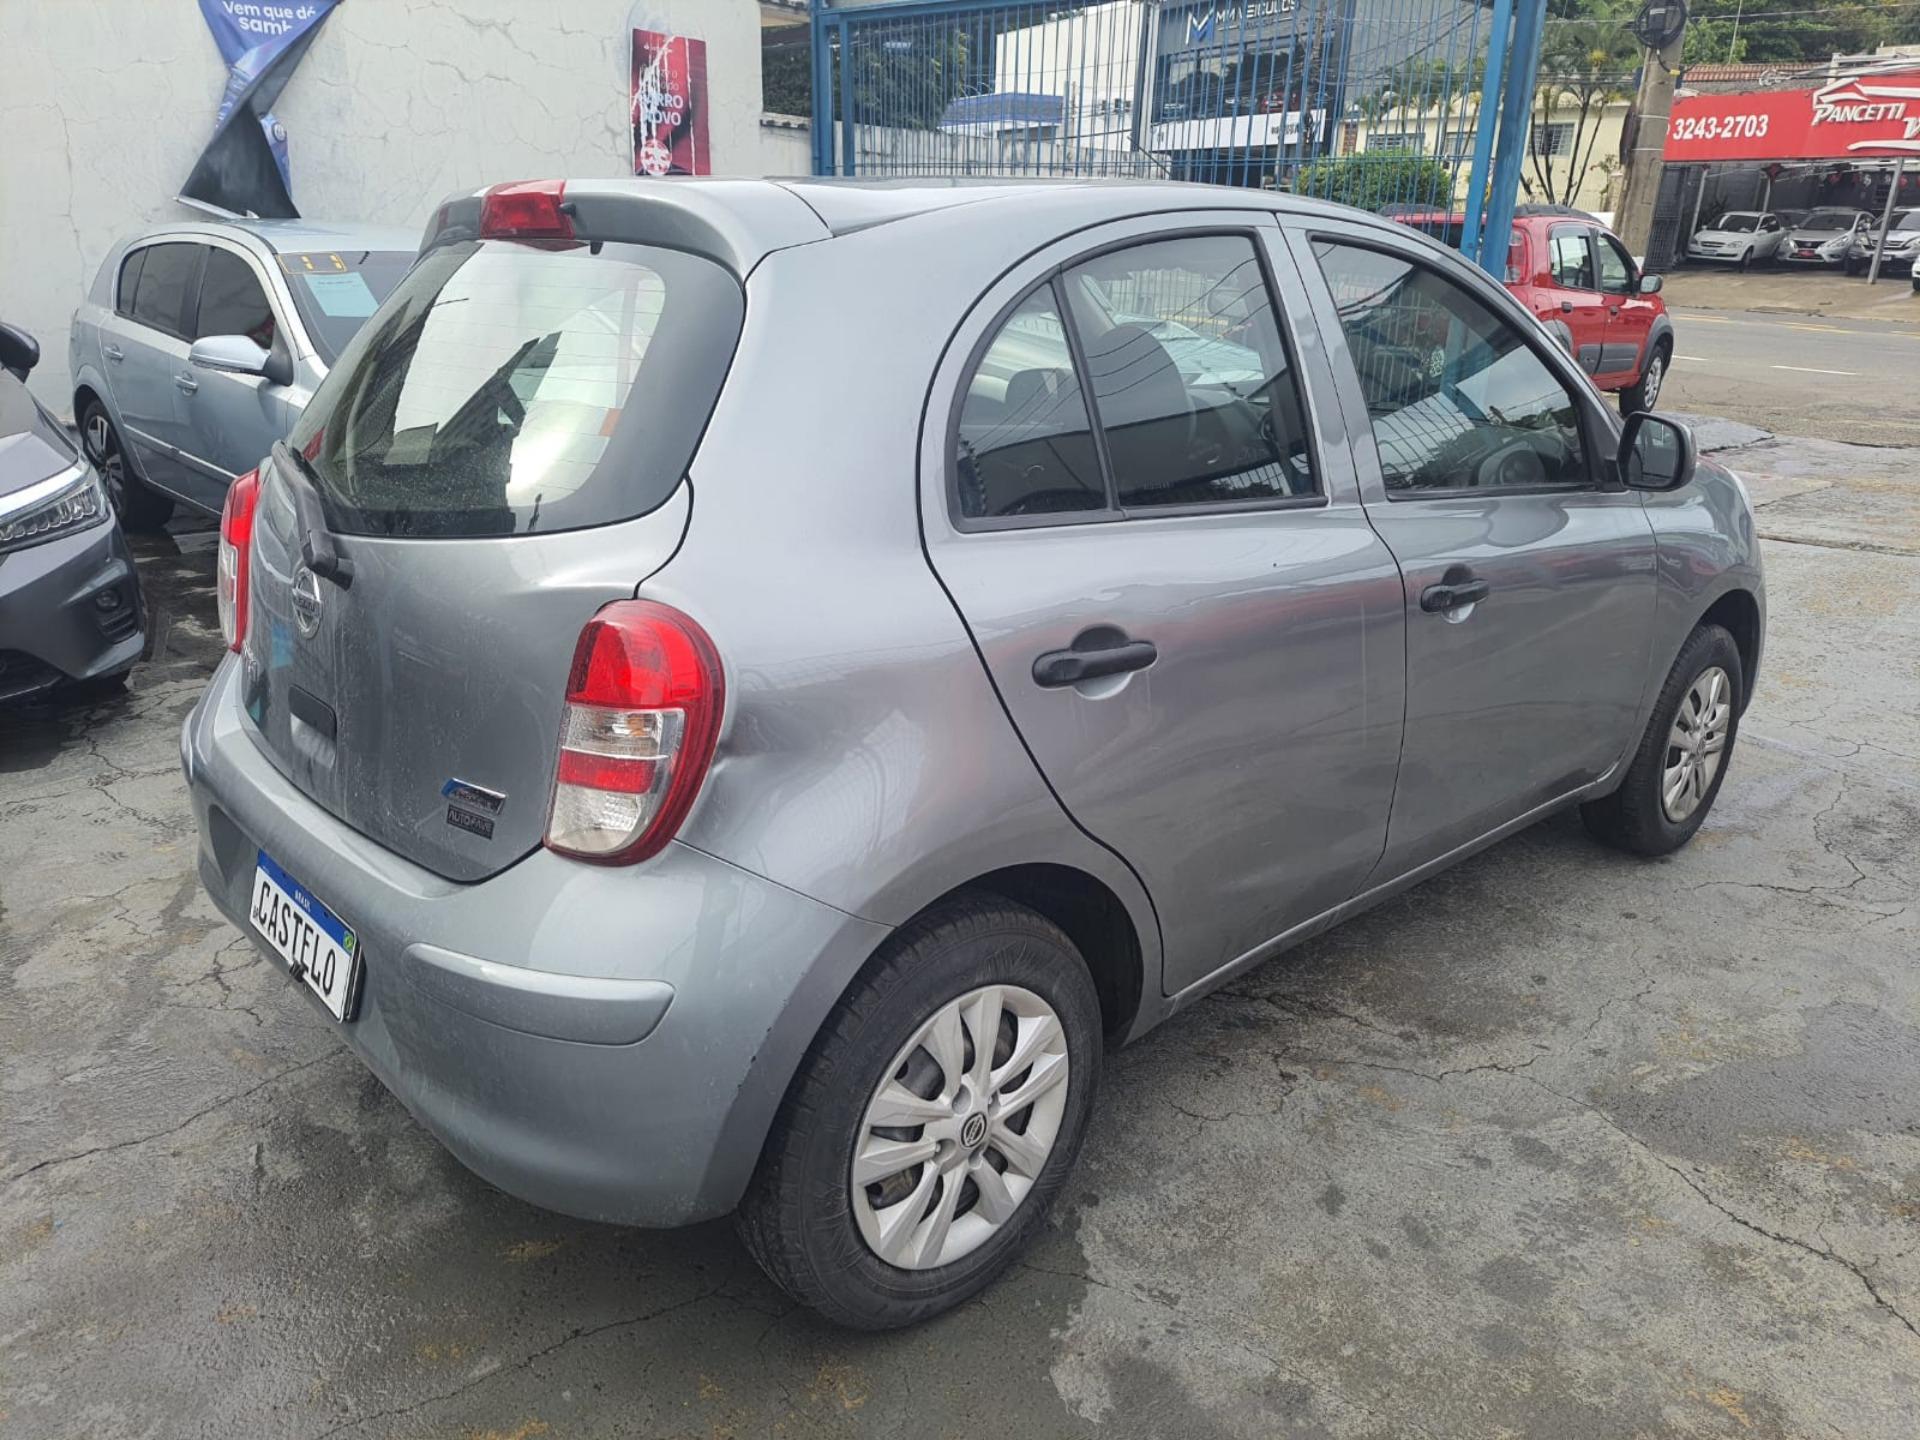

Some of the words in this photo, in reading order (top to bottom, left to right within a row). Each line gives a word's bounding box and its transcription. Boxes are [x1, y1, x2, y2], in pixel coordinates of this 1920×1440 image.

[222, 0, 260, 16] Vem
[263, 6, 294, 21] que
[1811, 102, 1906, 126] PANCETTI
[1672, 114, 1769, 140] 3243-2703
[258, 880, 336, 997] CASTELO
